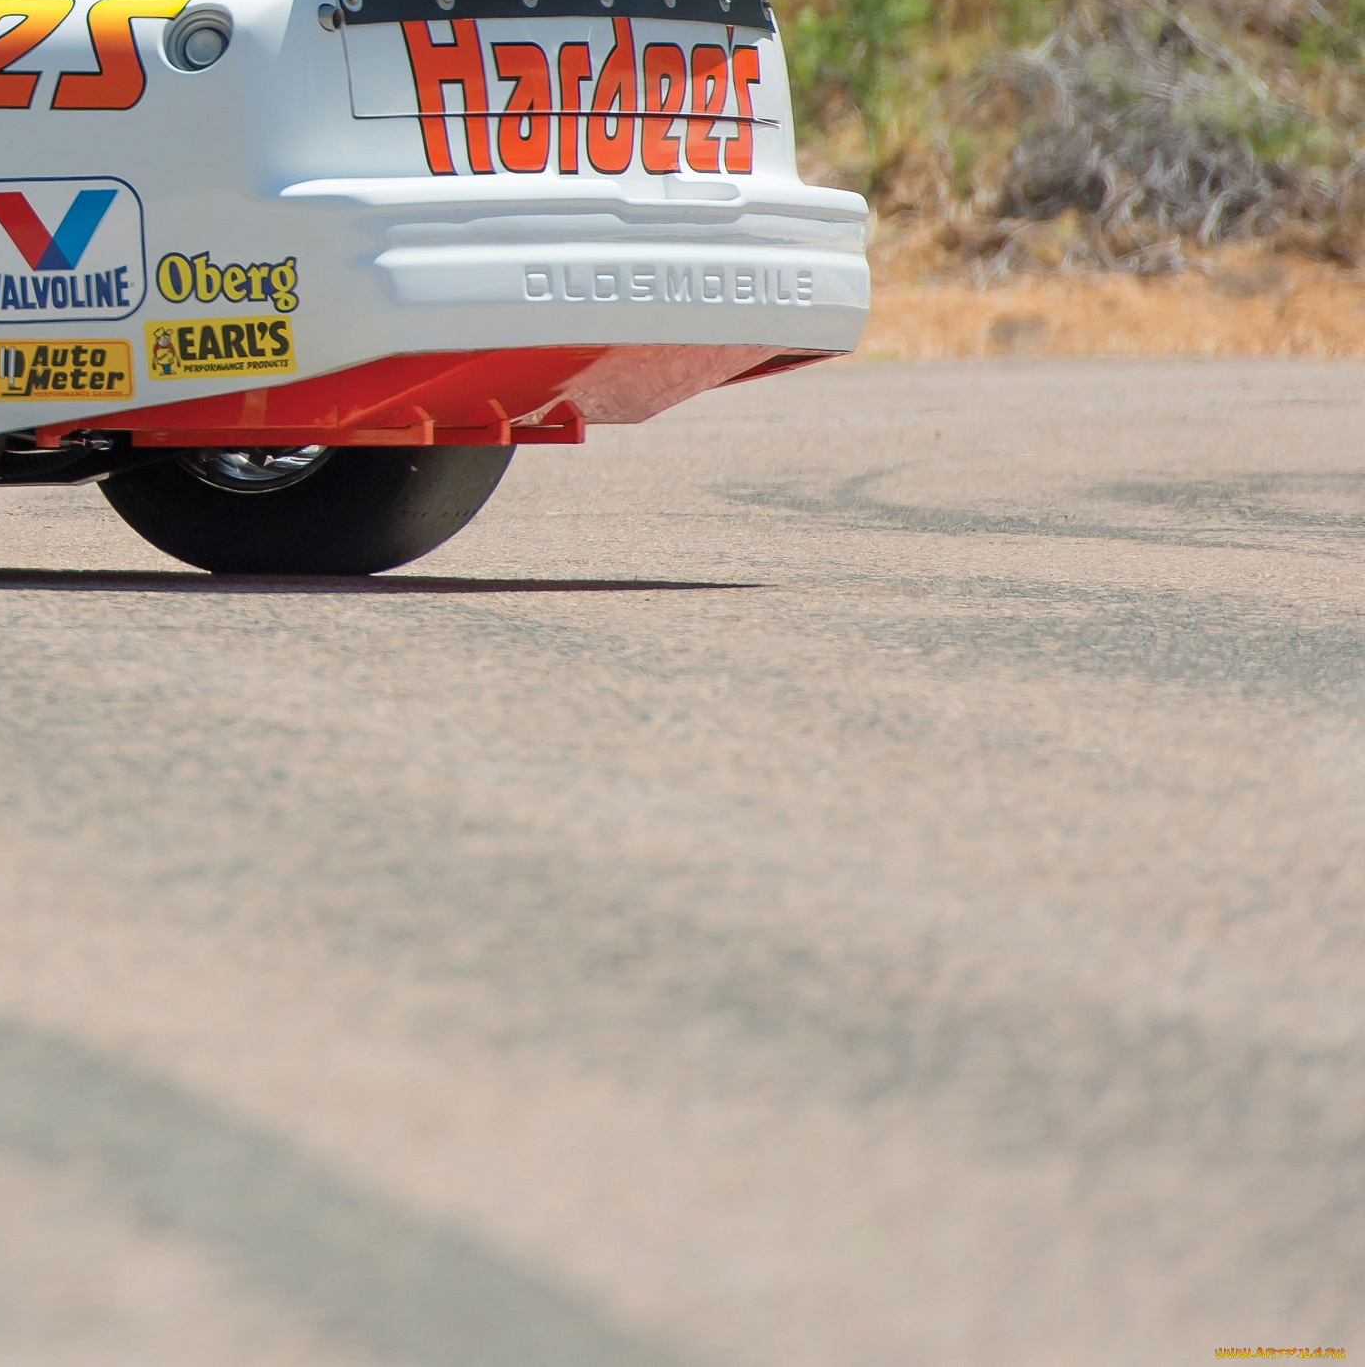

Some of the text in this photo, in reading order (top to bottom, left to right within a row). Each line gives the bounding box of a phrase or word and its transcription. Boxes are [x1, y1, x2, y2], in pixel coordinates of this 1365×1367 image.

[399, 17, 761, 176] Hardee's
[157, 252, 299, 313] Oberg
[523, 264, 812, 307] OLDSMOBILE
[31, 345, 107, 367] Auto
[178, 320, 290, 361] EARL'S
[25, 368, 125, 392] Meter
[183, 358, 289, 373] PERFORMANCE PRODUCTS
